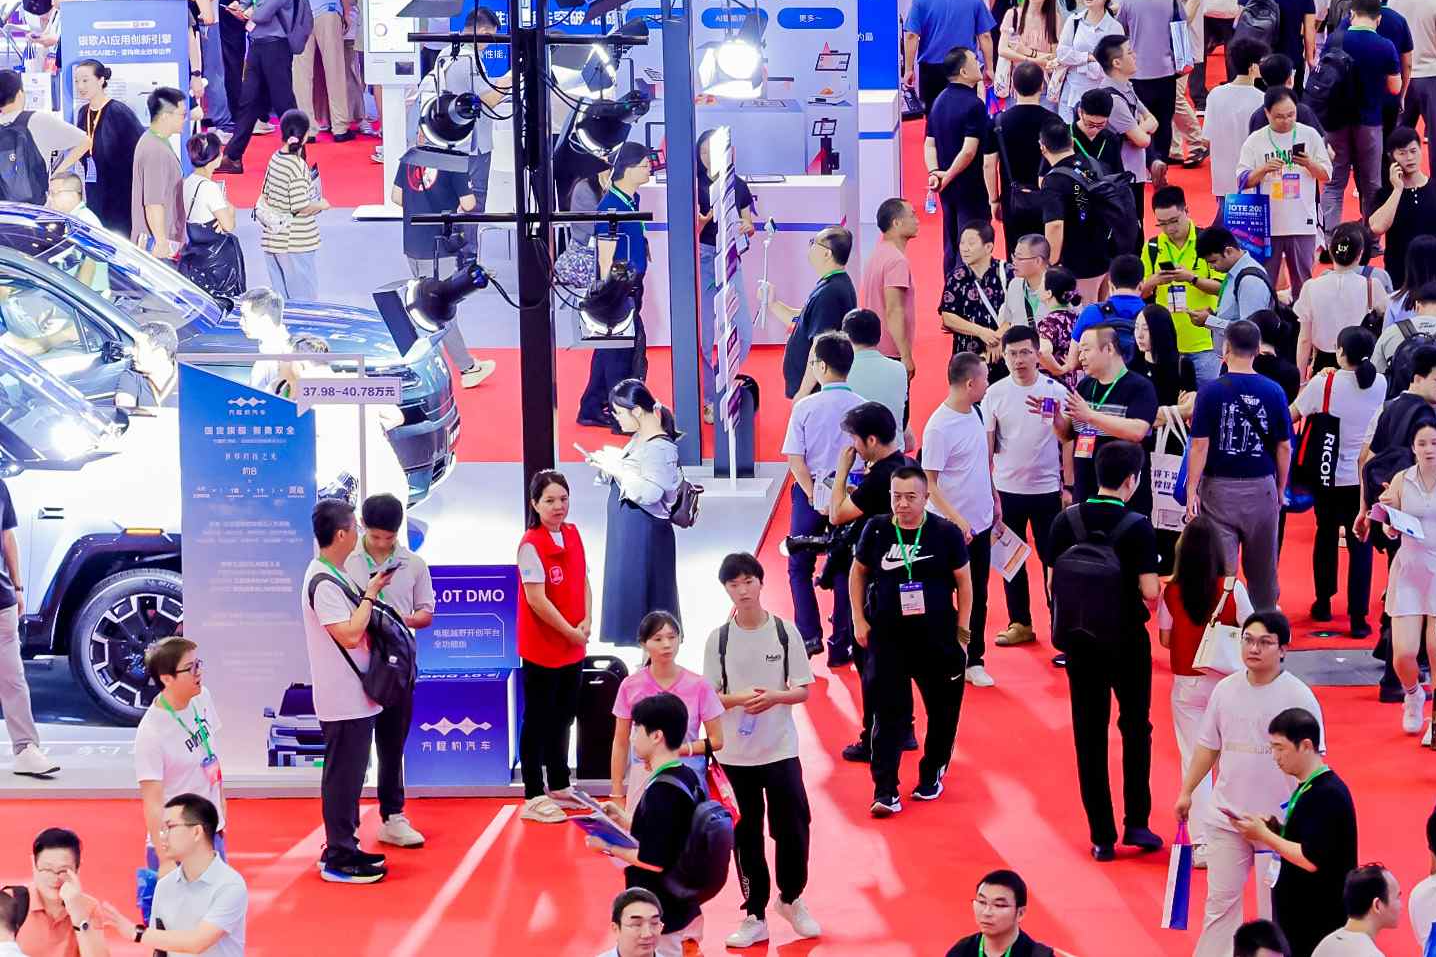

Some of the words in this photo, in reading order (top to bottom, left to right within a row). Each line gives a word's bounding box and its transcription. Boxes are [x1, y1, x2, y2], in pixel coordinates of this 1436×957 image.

[303, 386, 396, 398] 37.98-40.78万元
[1320, 432, 1336, 486] RICOH
[466, 589, 505, 603] DMO
